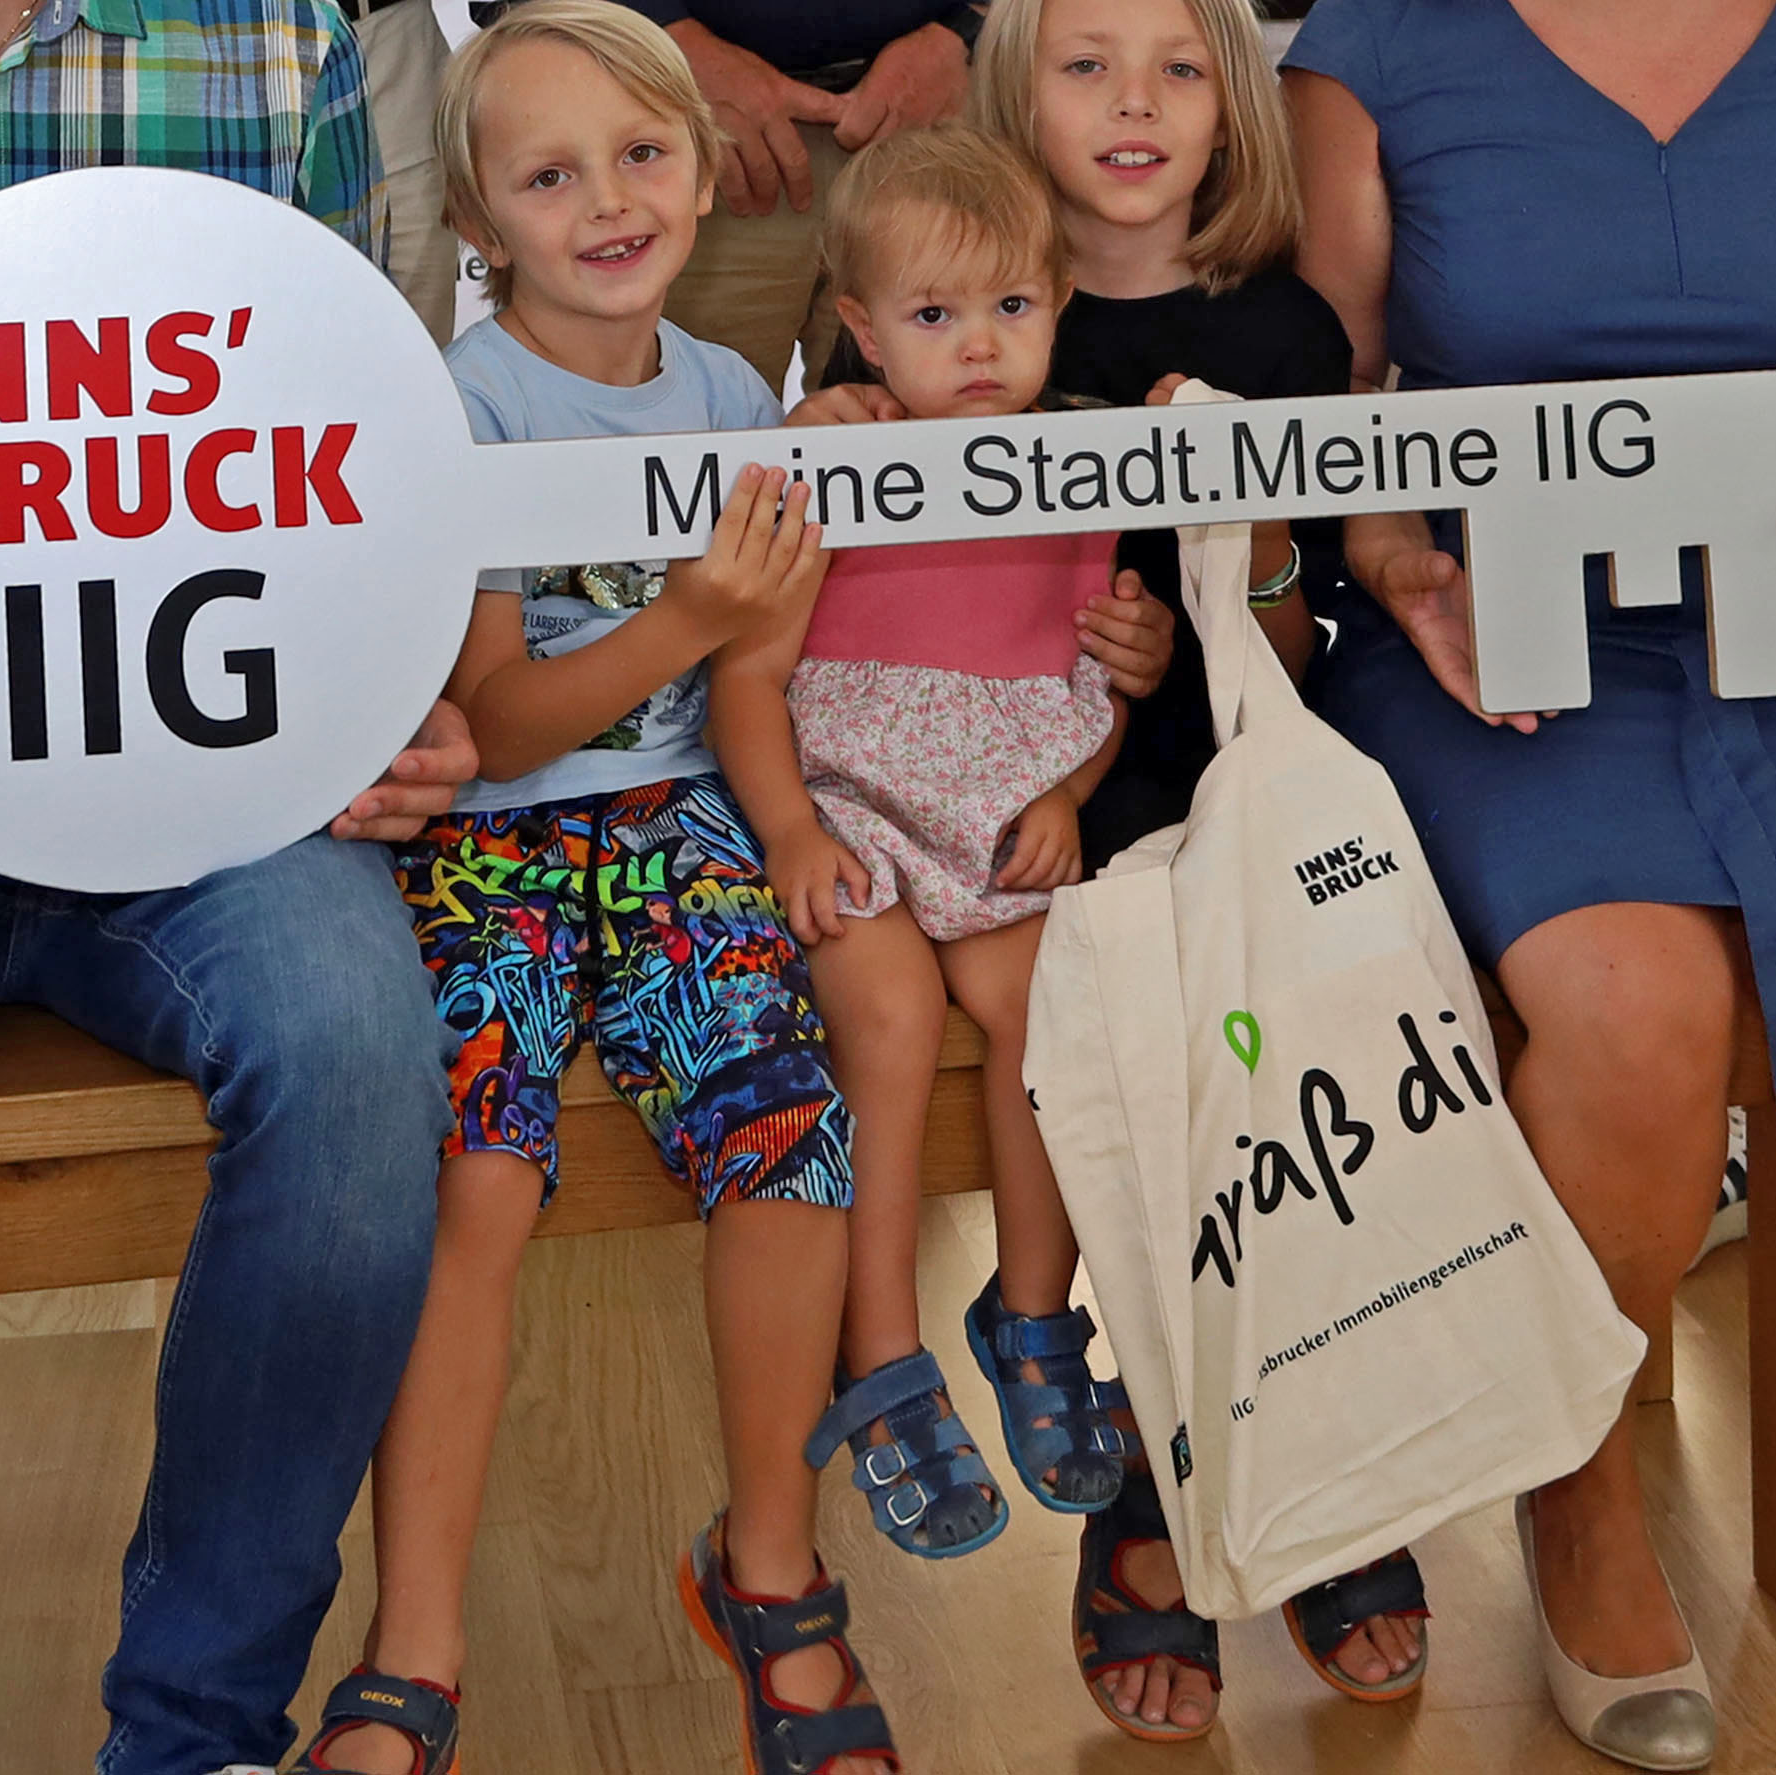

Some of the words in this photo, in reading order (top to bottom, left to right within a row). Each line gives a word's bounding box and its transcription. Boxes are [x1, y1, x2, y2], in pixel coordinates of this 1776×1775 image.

[645, 447, 924, 536] Mne
[1535, 399, 1656, 482] IIG
[5, 568, 279, 762] IIG
[1305, 851, 1400, 906] BRUCK
[1397, 1011, 1493, 1133] di
[1230, 1396, 1255, 1421] IIG
[1333, 1221, 1529, 1336] Immobiliengesellschaft
[360, 1690, 406, 1708] GEOX
